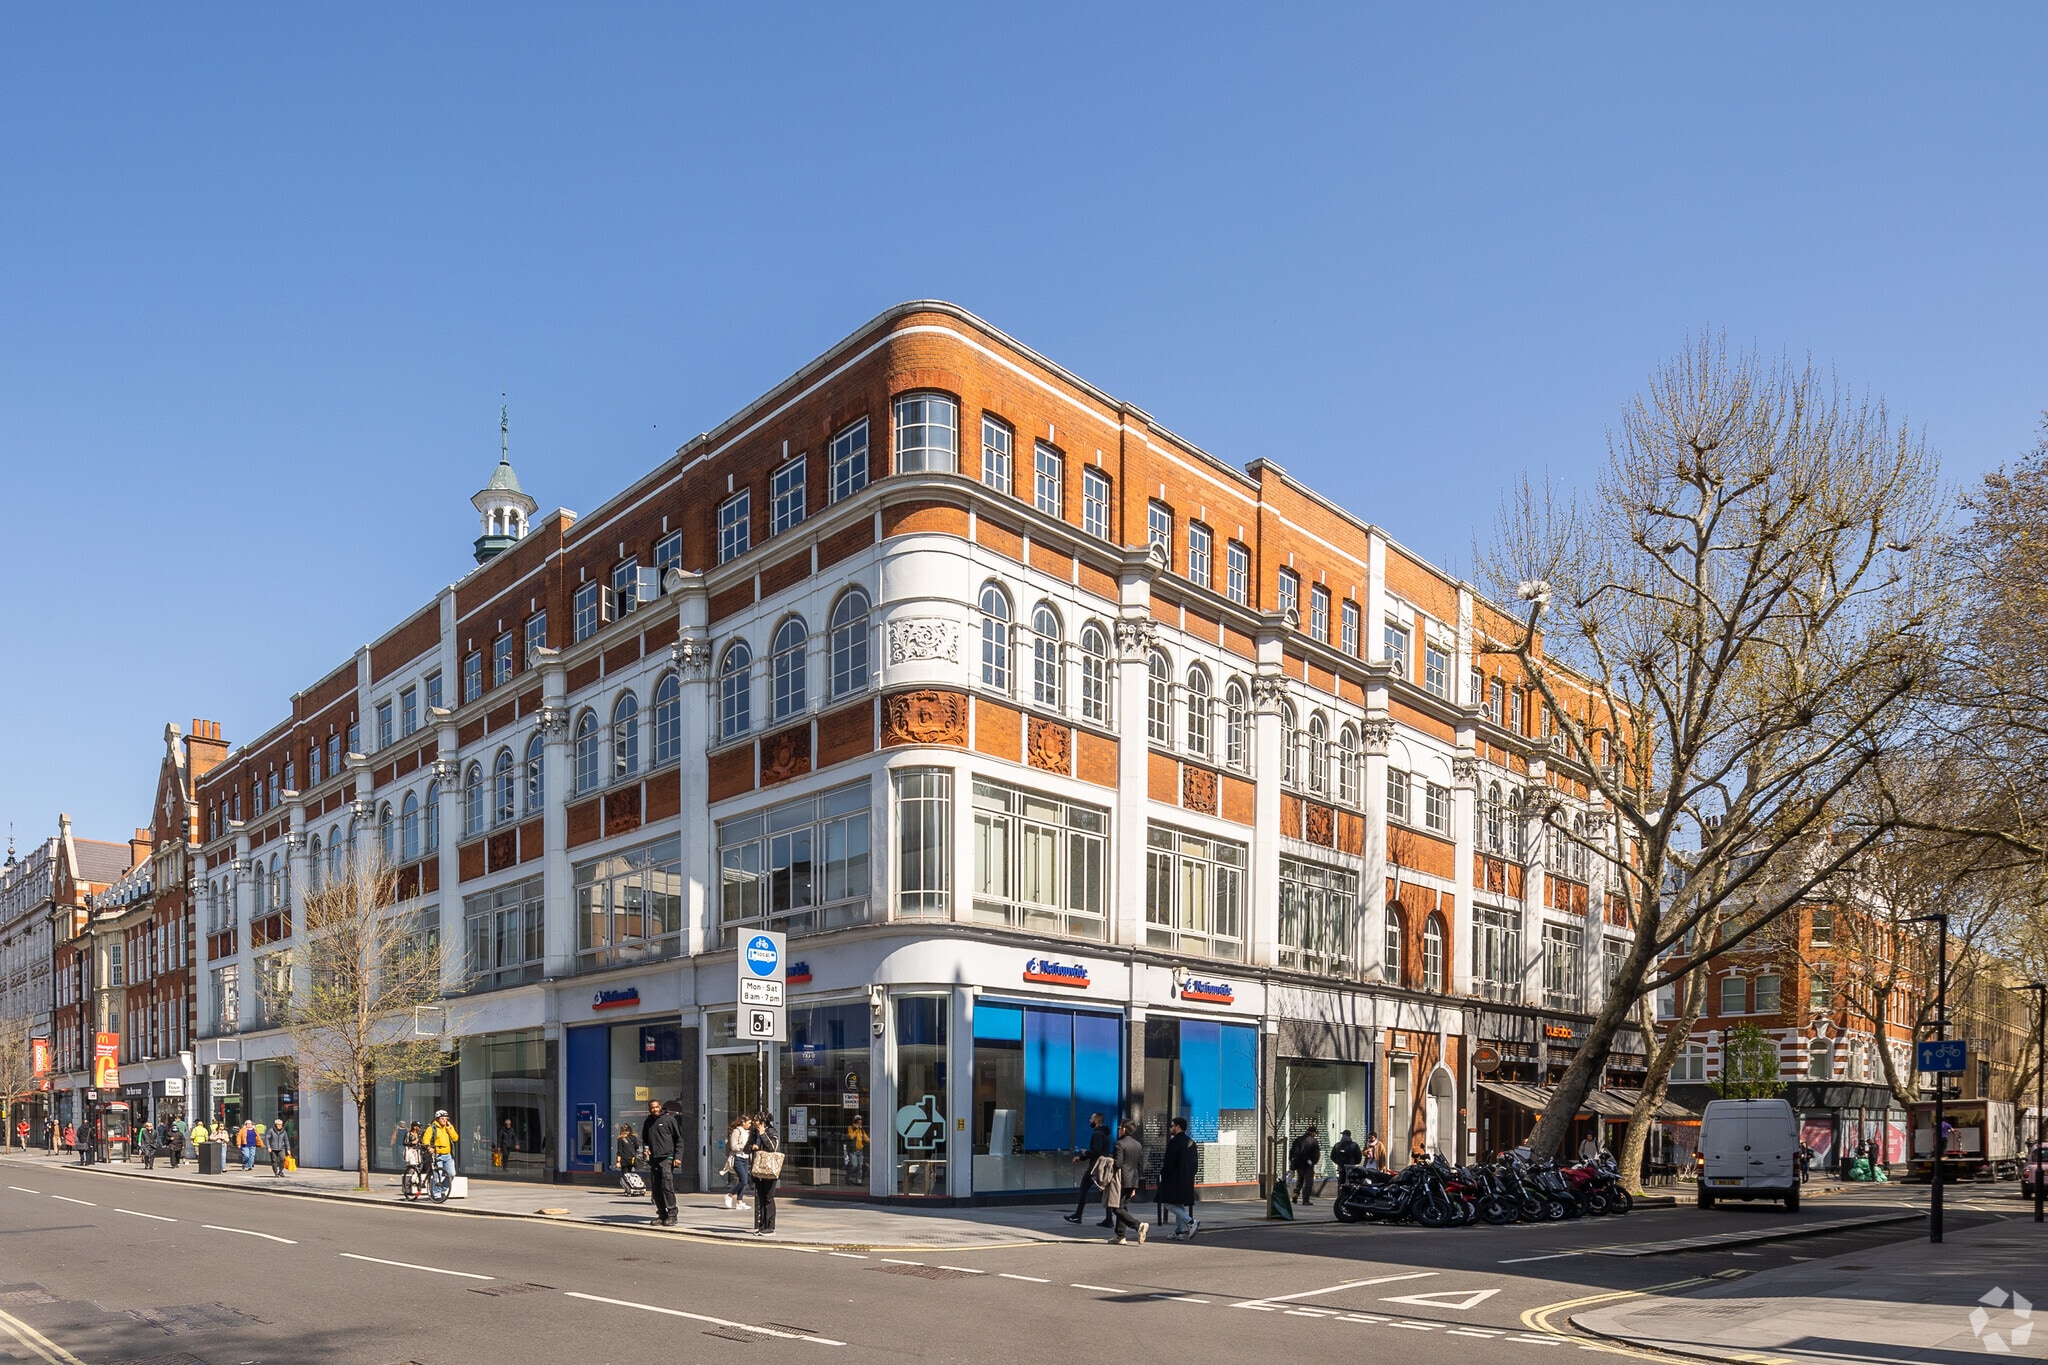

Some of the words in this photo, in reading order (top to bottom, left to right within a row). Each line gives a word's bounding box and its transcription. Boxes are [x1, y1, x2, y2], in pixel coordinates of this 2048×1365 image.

[1040, 960, 1088, 978] Nationwide
[747, 983, 761, 991] Mon
[766, 984, 778, 993] Sat
[1194, 981, 1232, 996] Nationwide
[1546, 1023, 1572, 1039] busaba
